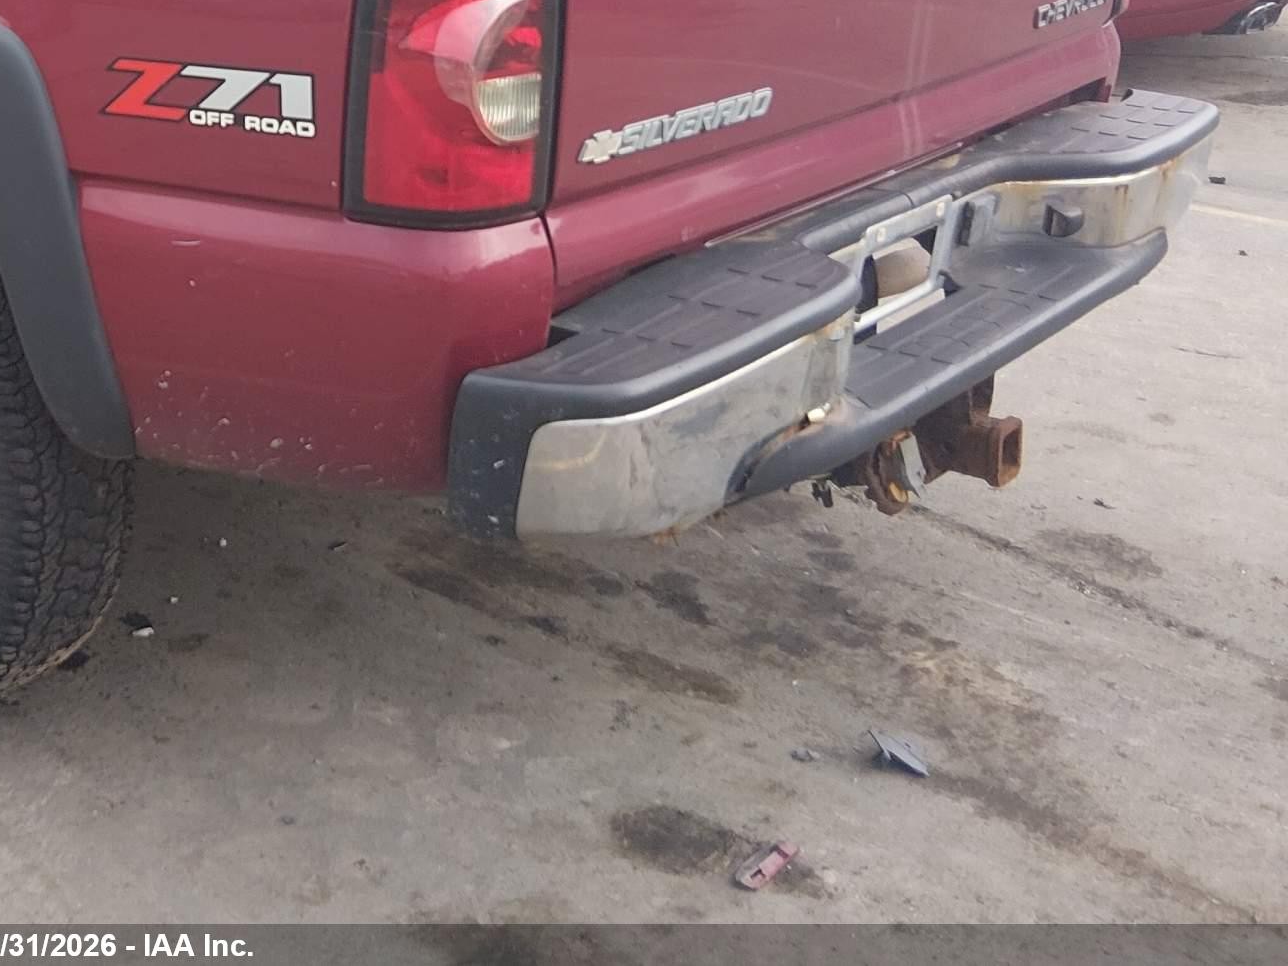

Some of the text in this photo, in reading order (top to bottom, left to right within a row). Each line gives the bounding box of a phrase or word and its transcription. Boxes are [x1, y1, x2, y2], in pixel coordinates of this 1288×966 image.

[101, 57, 313, 122] Z71
[617, 86, 773, 155] SILVERADO
[188, 108, 316, 138] OFF ROAD
